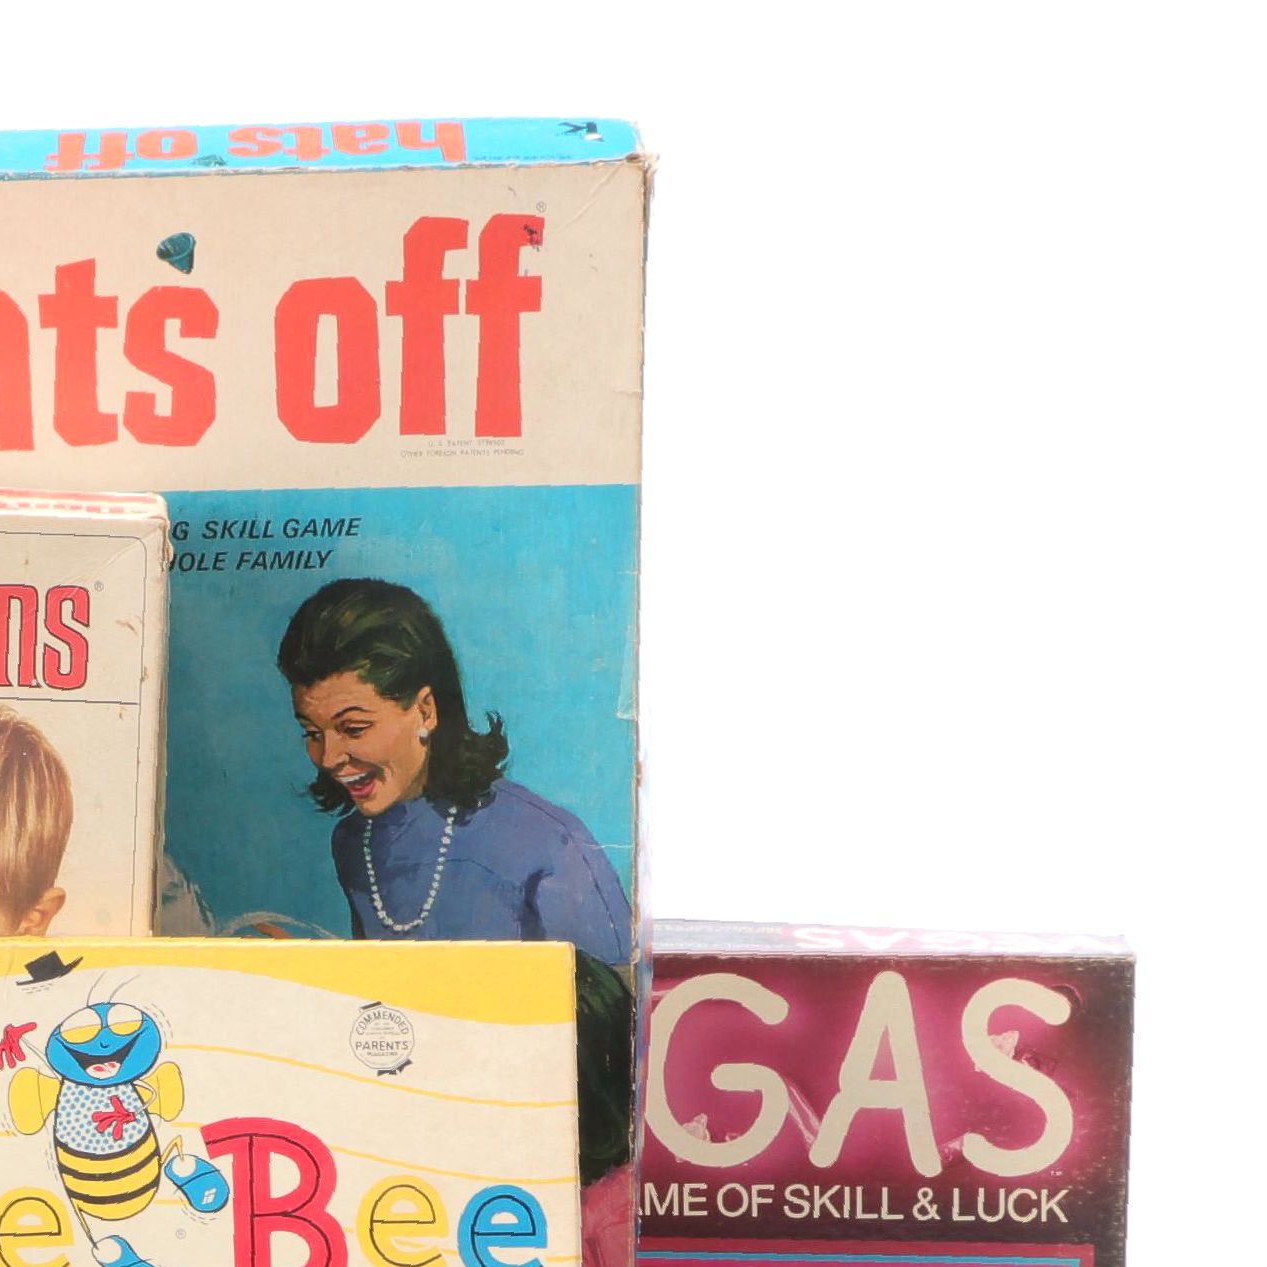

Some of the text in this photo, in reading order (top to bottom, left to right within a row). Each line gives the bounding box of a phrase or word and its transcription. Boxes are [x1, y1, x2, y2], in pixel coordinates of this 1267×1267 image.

[44, 121, 466, 172] hats off
[275, 213, 544, 445] off
[202, 519, 274, 539] SKILL
[283, 518, 362, 538] GAME
[169, 550, 333, 571] OLE FAMILY
[355, 1010, 410, 1036] COMMENDED
[644, 971, 1074, 1178] GAS
[638, 1182, 1069, 1223] ME OF SKILL & LUCK
